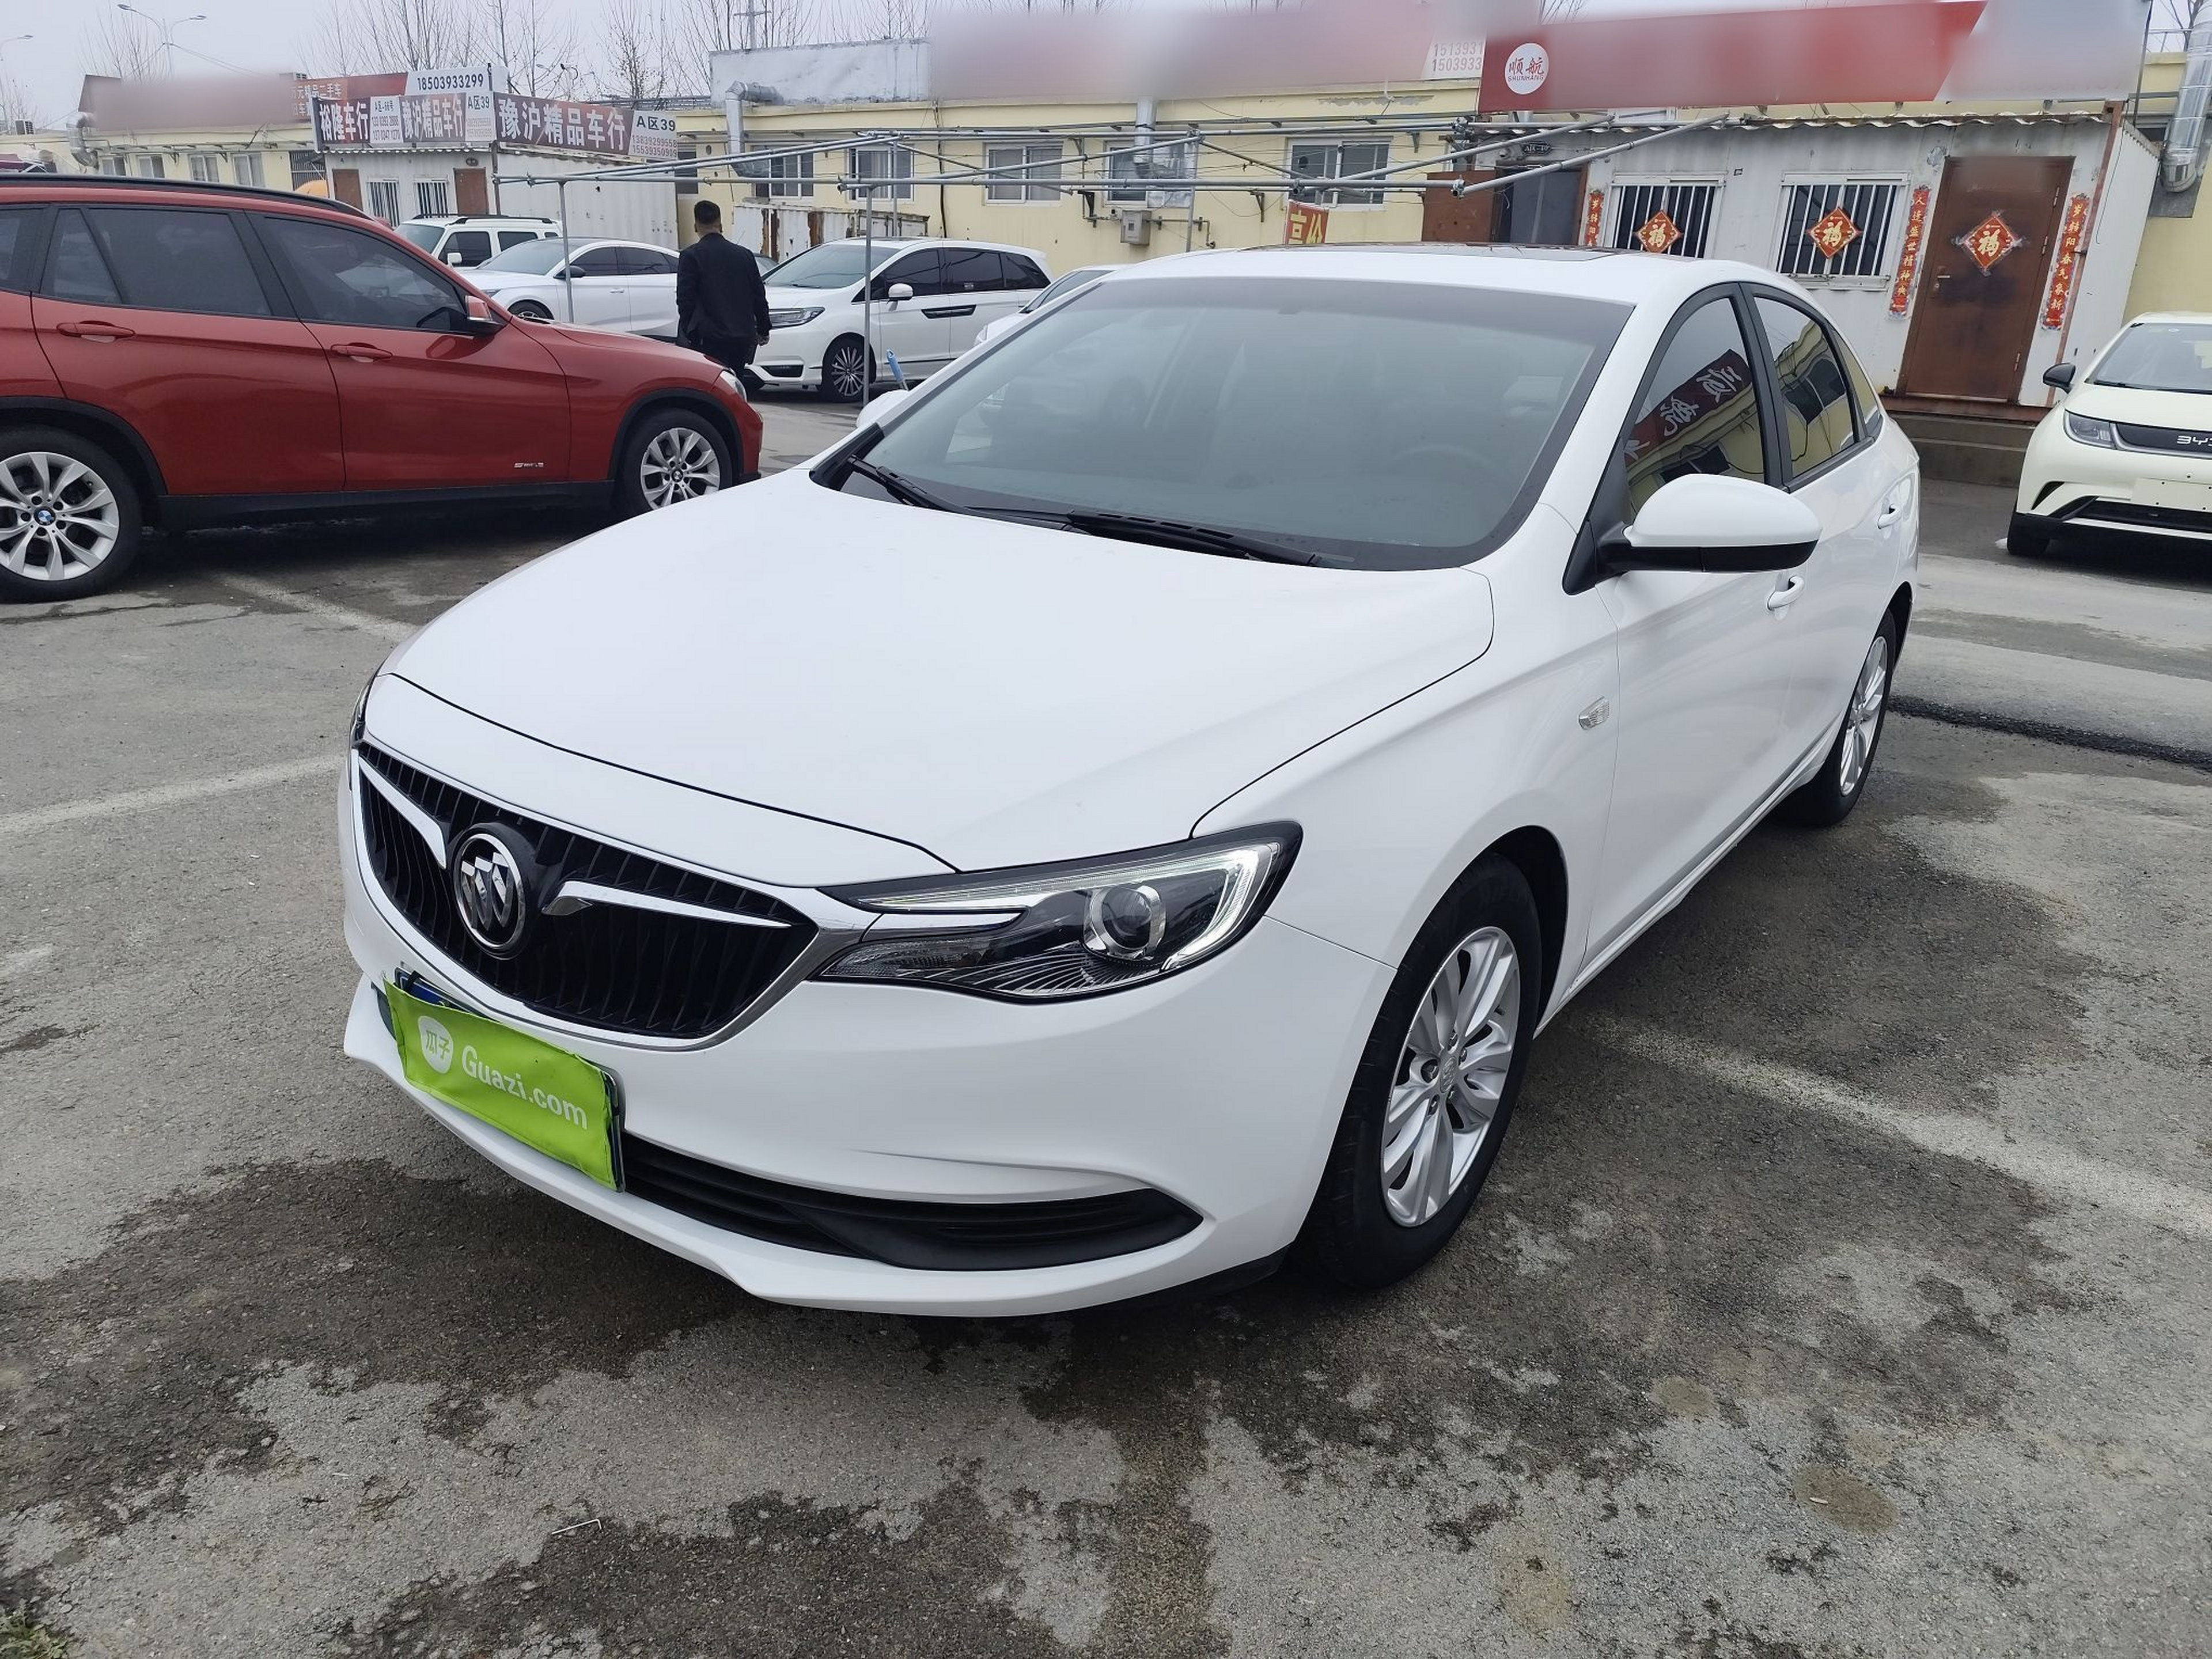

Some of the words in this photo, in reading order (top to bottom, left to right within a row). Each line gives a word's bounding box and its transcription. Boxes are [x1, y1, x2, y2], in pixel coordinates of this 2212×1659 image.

[1509, 56, 1544, 75] 顺航
[417, 73, 484, 90] 18503933299
[468, 95, 490, 109] A区39
[319, 101, 369, 141] 裕隆车行
[498, 98, 626, 151] 豫沪精品车行
[637, 115, 676, 131] A区39
[1647, 222, 1666, 248] 福
[1822, 220, 1843, 247] 福
[1978, 228, 2001, 257] 福
[2176, 435, 2212, 447] BY
[425, 1030, 450, 1060] 瓜子
[461, 1045, 588, 1130] Guazi.com
